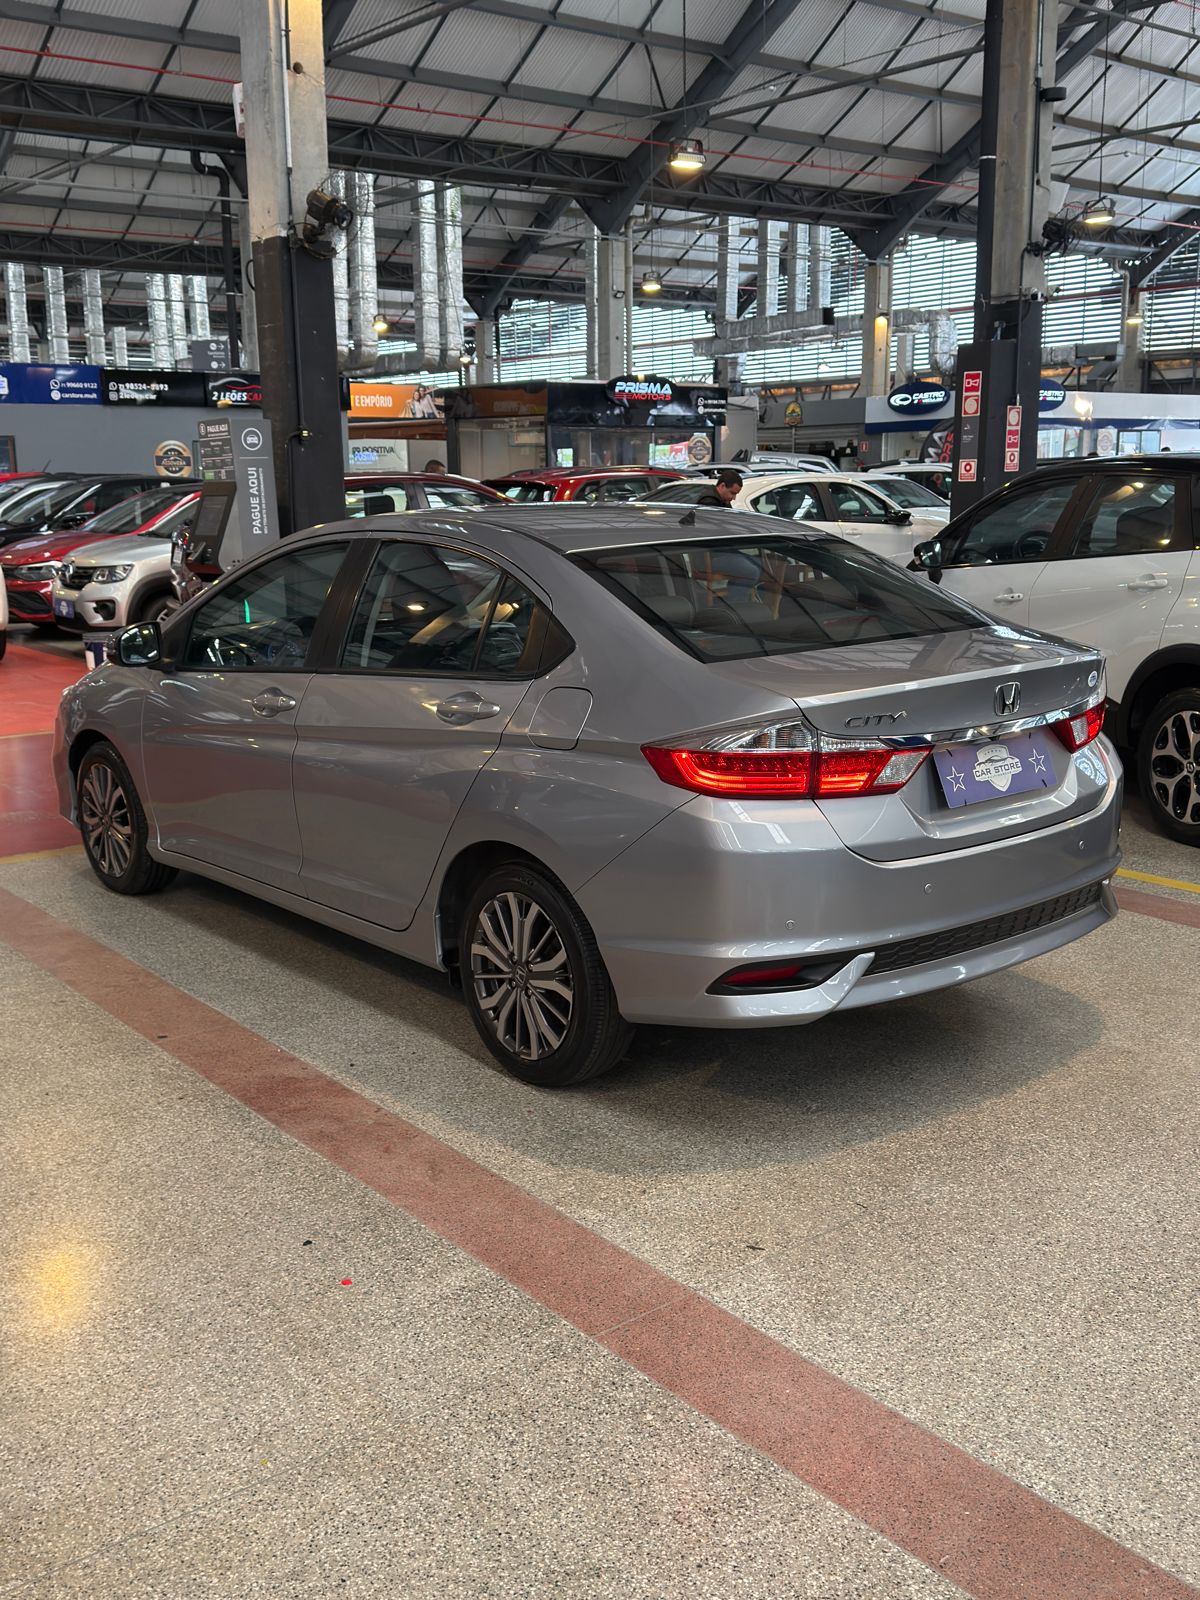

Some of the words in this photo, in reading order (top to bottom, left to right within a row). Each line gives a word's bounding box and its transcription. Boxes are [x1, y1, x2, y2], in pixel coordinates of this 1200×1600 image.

[614, 381, 672, 394] PRISMA
[360, 394, 393, 408] EMPÓRIO
[631, 393, 672, 401] MOTORS
[912, 391, 945, 400] CASTRO
[362, 446, 395, 454] POSITIVA
[247, 467, 259, 495] AQUI
[250, 496, 263, 534] PAGUE
[844, 710, 907, 728] CITY
[974, 767, 992, 778] CAR
[993, 761, 1021, 774] STORE
